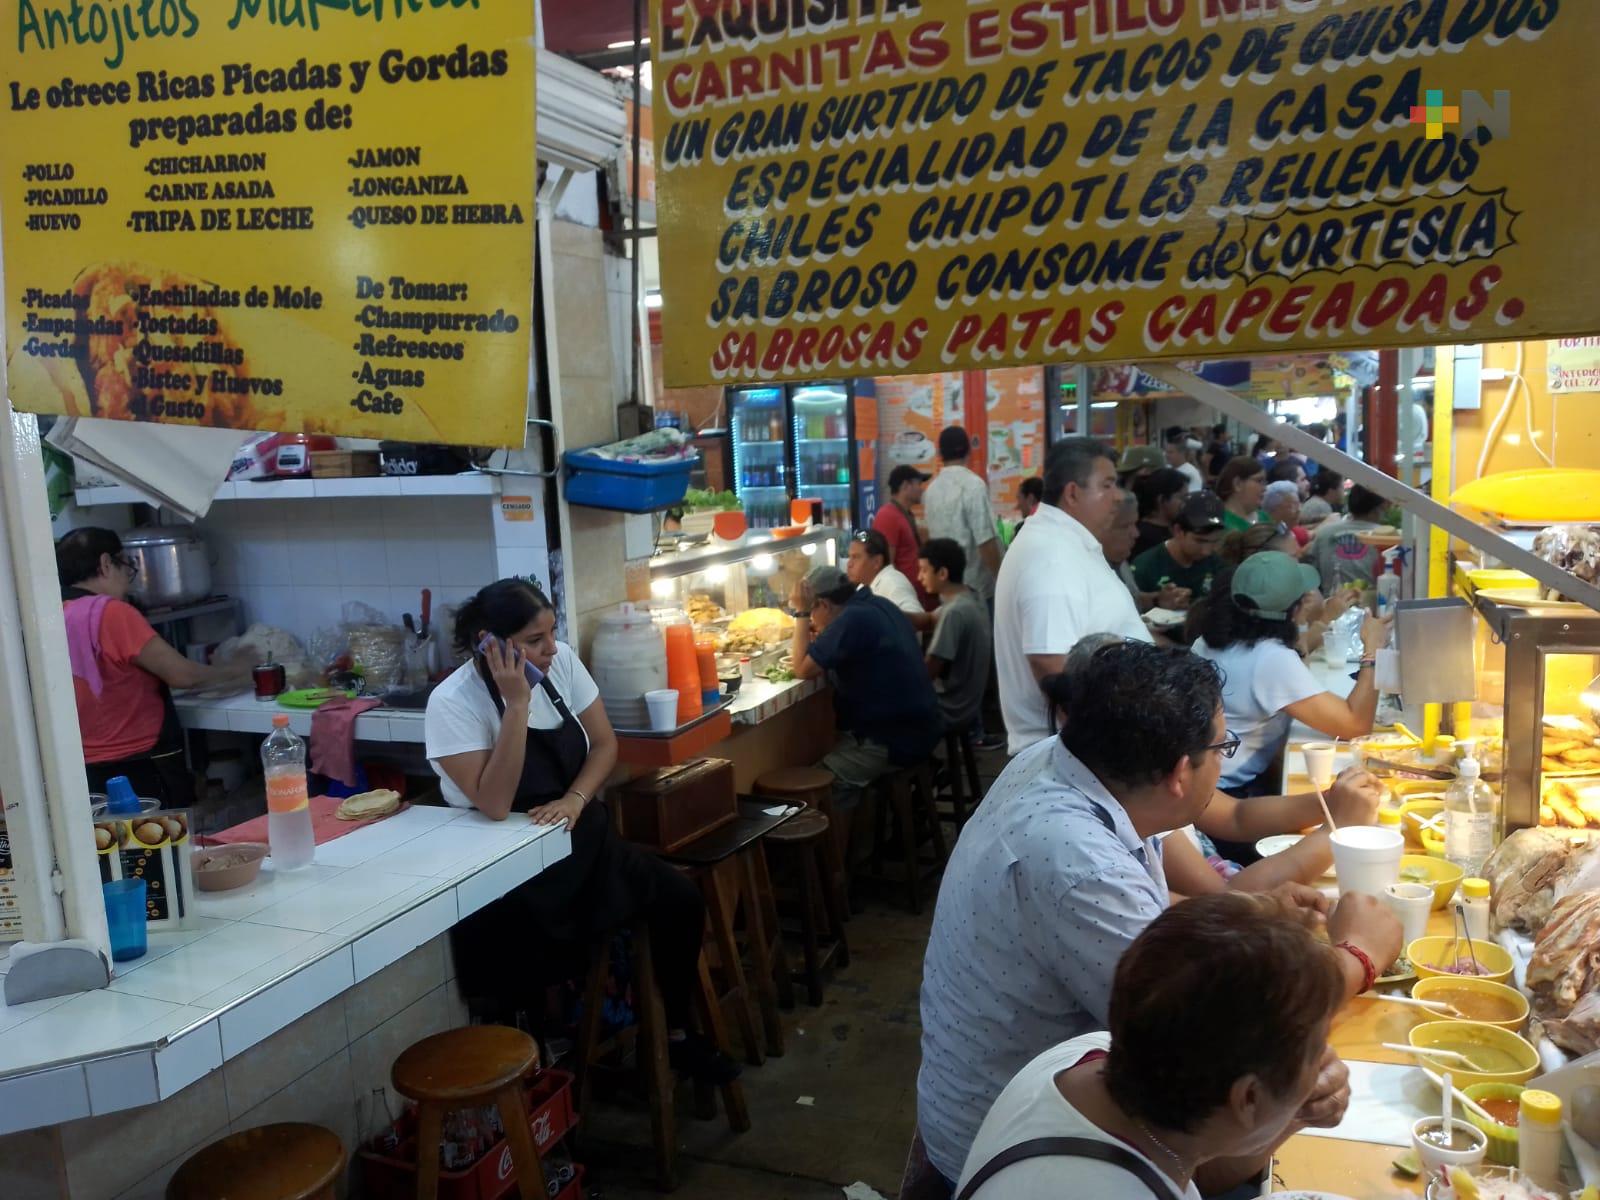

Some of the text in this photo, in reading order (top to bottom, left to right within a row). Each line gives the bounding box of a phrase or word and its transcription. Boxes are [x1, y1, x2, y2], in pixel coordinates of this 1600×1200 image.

[18, 0, 200, 69] Antojitos
[667, 0, 1185, 111] CARNITAS ESTILO
[9, 44, 508, 111] Le ofrece Ricas Picadas y Gordas
[665, 0, 1559, 164] UN GRAN SURTIDO DE TACOS DE GUISADOS
[129, 99, 352, 148] preparadas de:
[727, 67, 1422, 213] ESPECIALIDAD DE LA CASA
[200, 209, 231, 231] DE
[236, 207, 314, 230] LECHE
[211, 180, 275, 200] ASADA
[421, 205, 448, 224] DE
[452, 204, 524, 224] HEBRA
[719, 125, 1491, 266] CHILES CHIPOTLES RELLENOS
[355, 276, 468, 302] De Tomar:
[710, 198, 1497, 323] SABROSO CONSOME de CORTESIA
[245, 285, 269, 308] de
[273, 286, 323, 309] Mole
[712, 265, 1525, 373] SABROSAS PATAS CAPEADAS.
[152, 396, 206, 419] Gusto
[194, 373, 208, 395] y
[211, 370, 283, 396] Huevos
